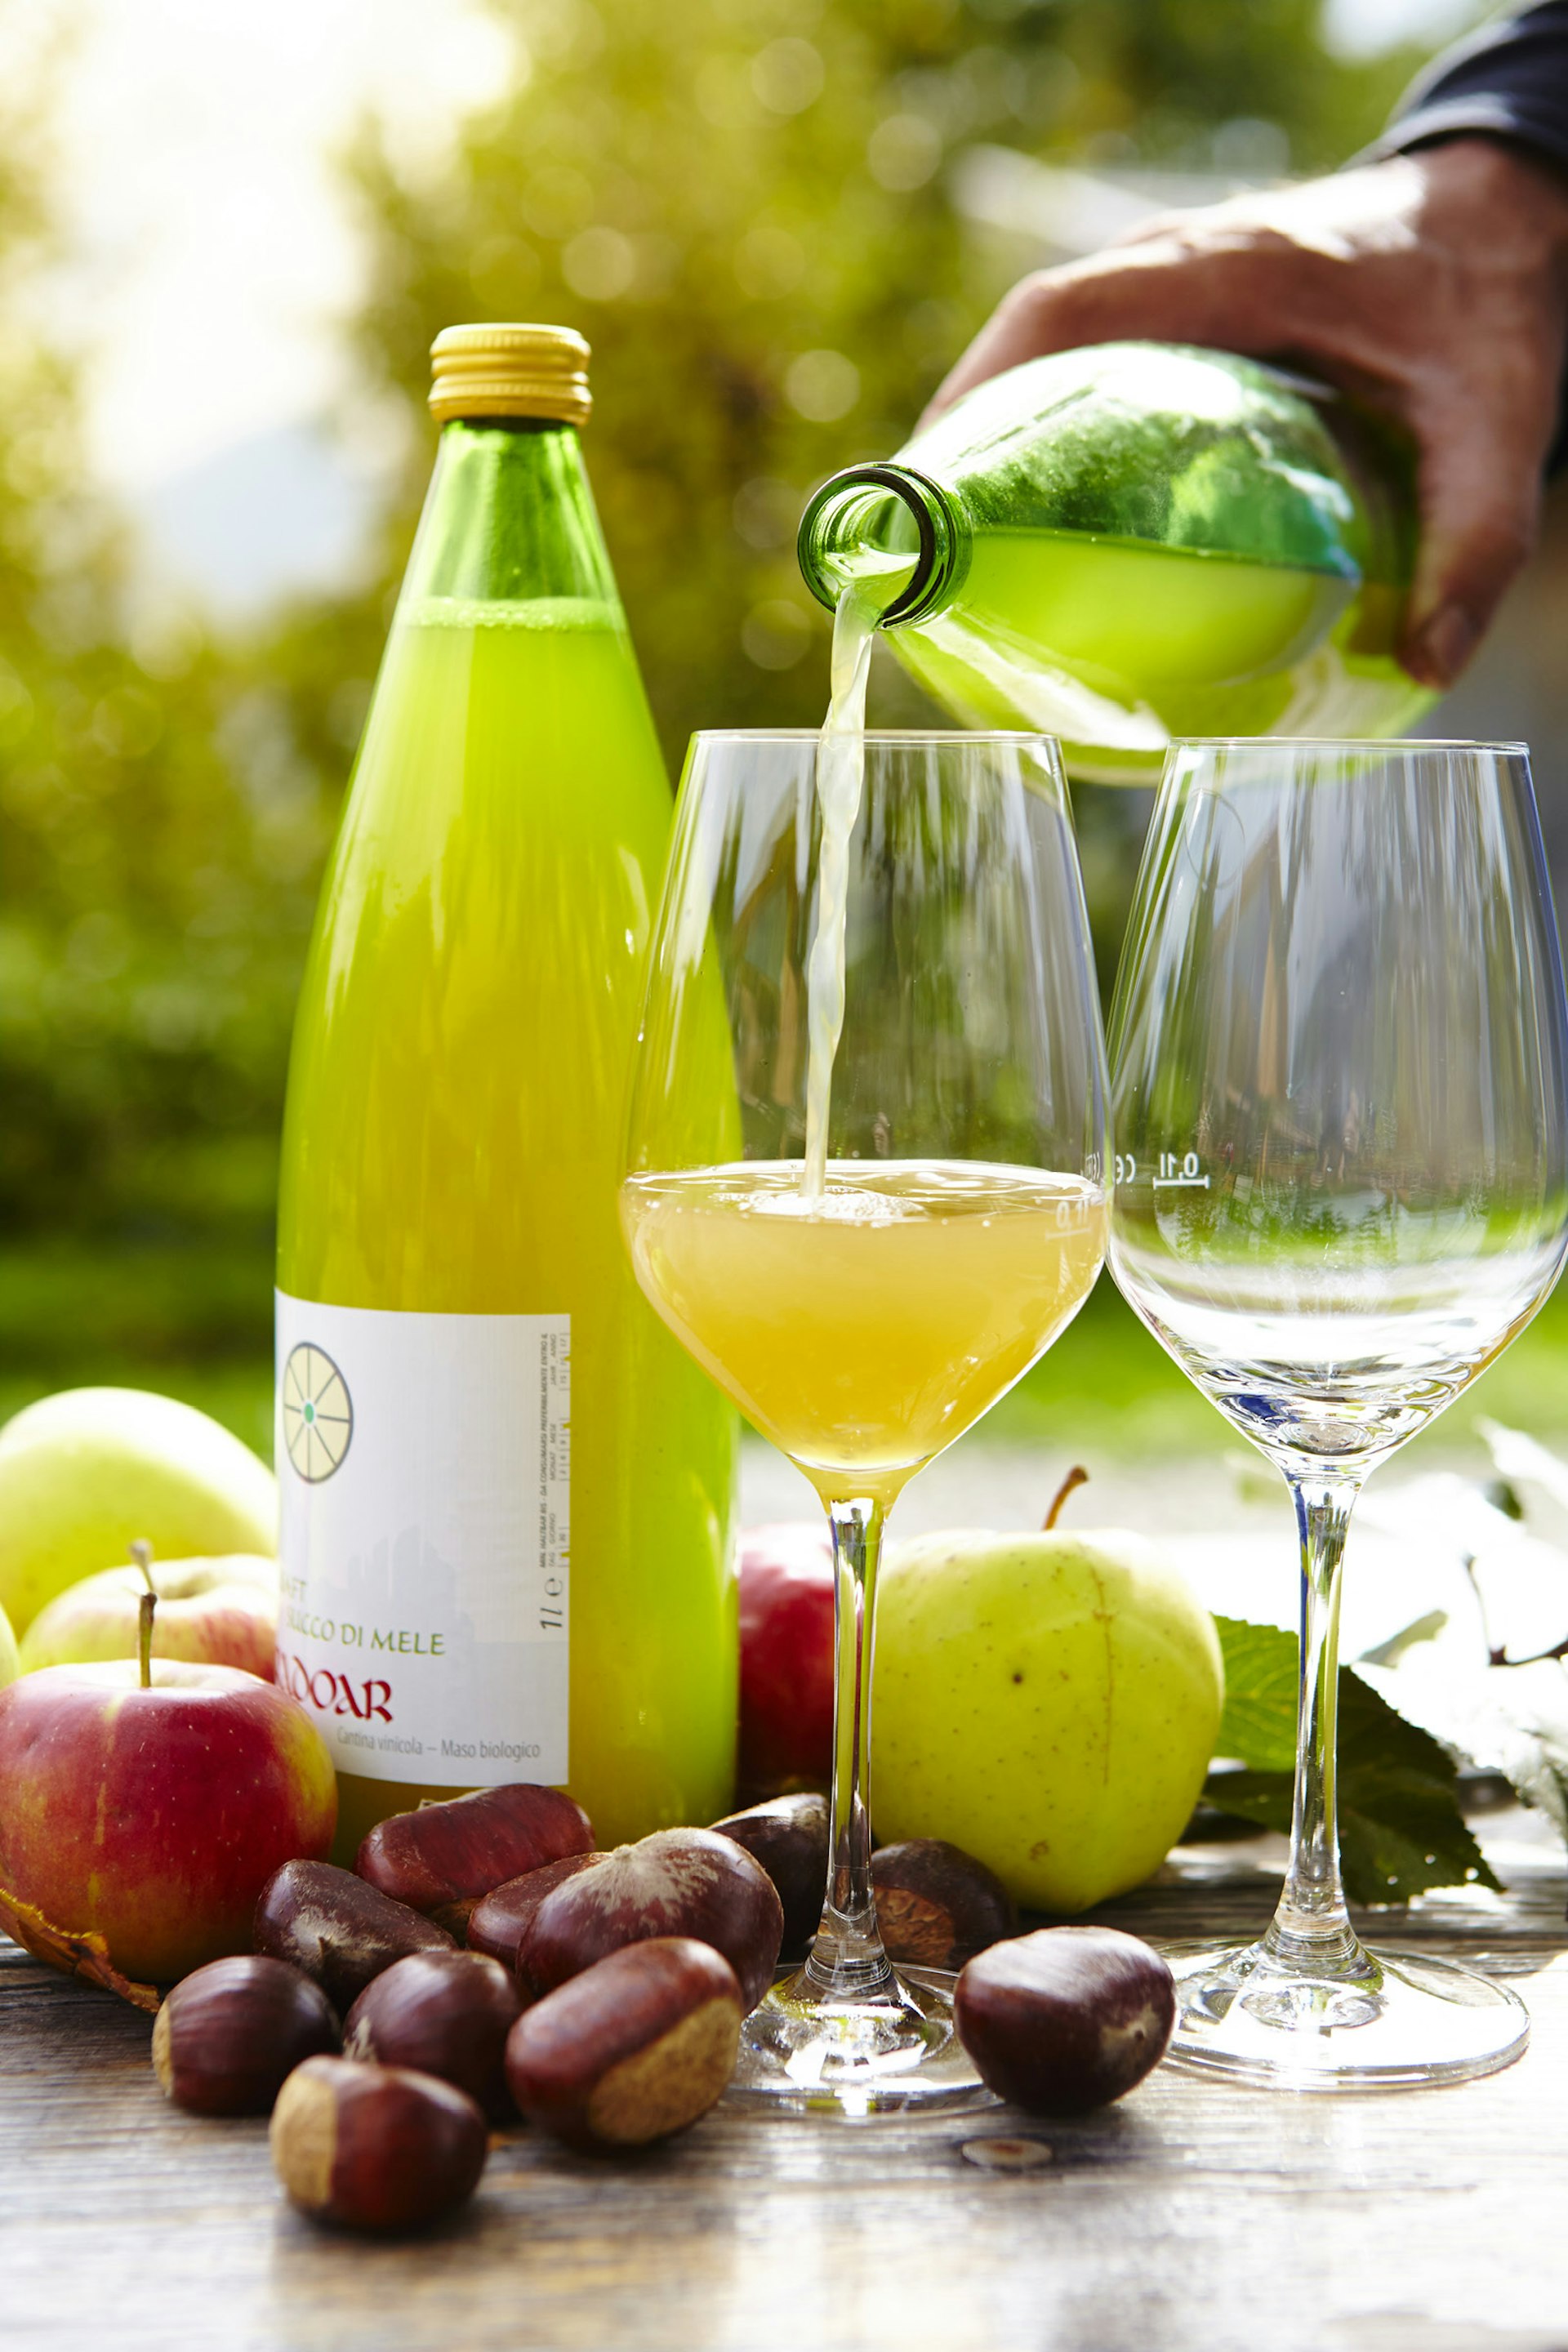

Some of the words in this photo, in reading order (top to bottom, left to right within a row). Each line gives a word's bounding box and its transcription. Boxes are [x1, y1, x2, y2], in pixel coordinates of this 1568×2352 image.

[341, 1624, 363, 1648] DI
[371, 1628, 446, 1656] MELE
[337, 1726, 376, 1750] Cantina
[377, 1735, 423, 1755] vinicola
[441, 1739, 477, 1758] Maso
[480, 1740, 541, 1762] biologico
